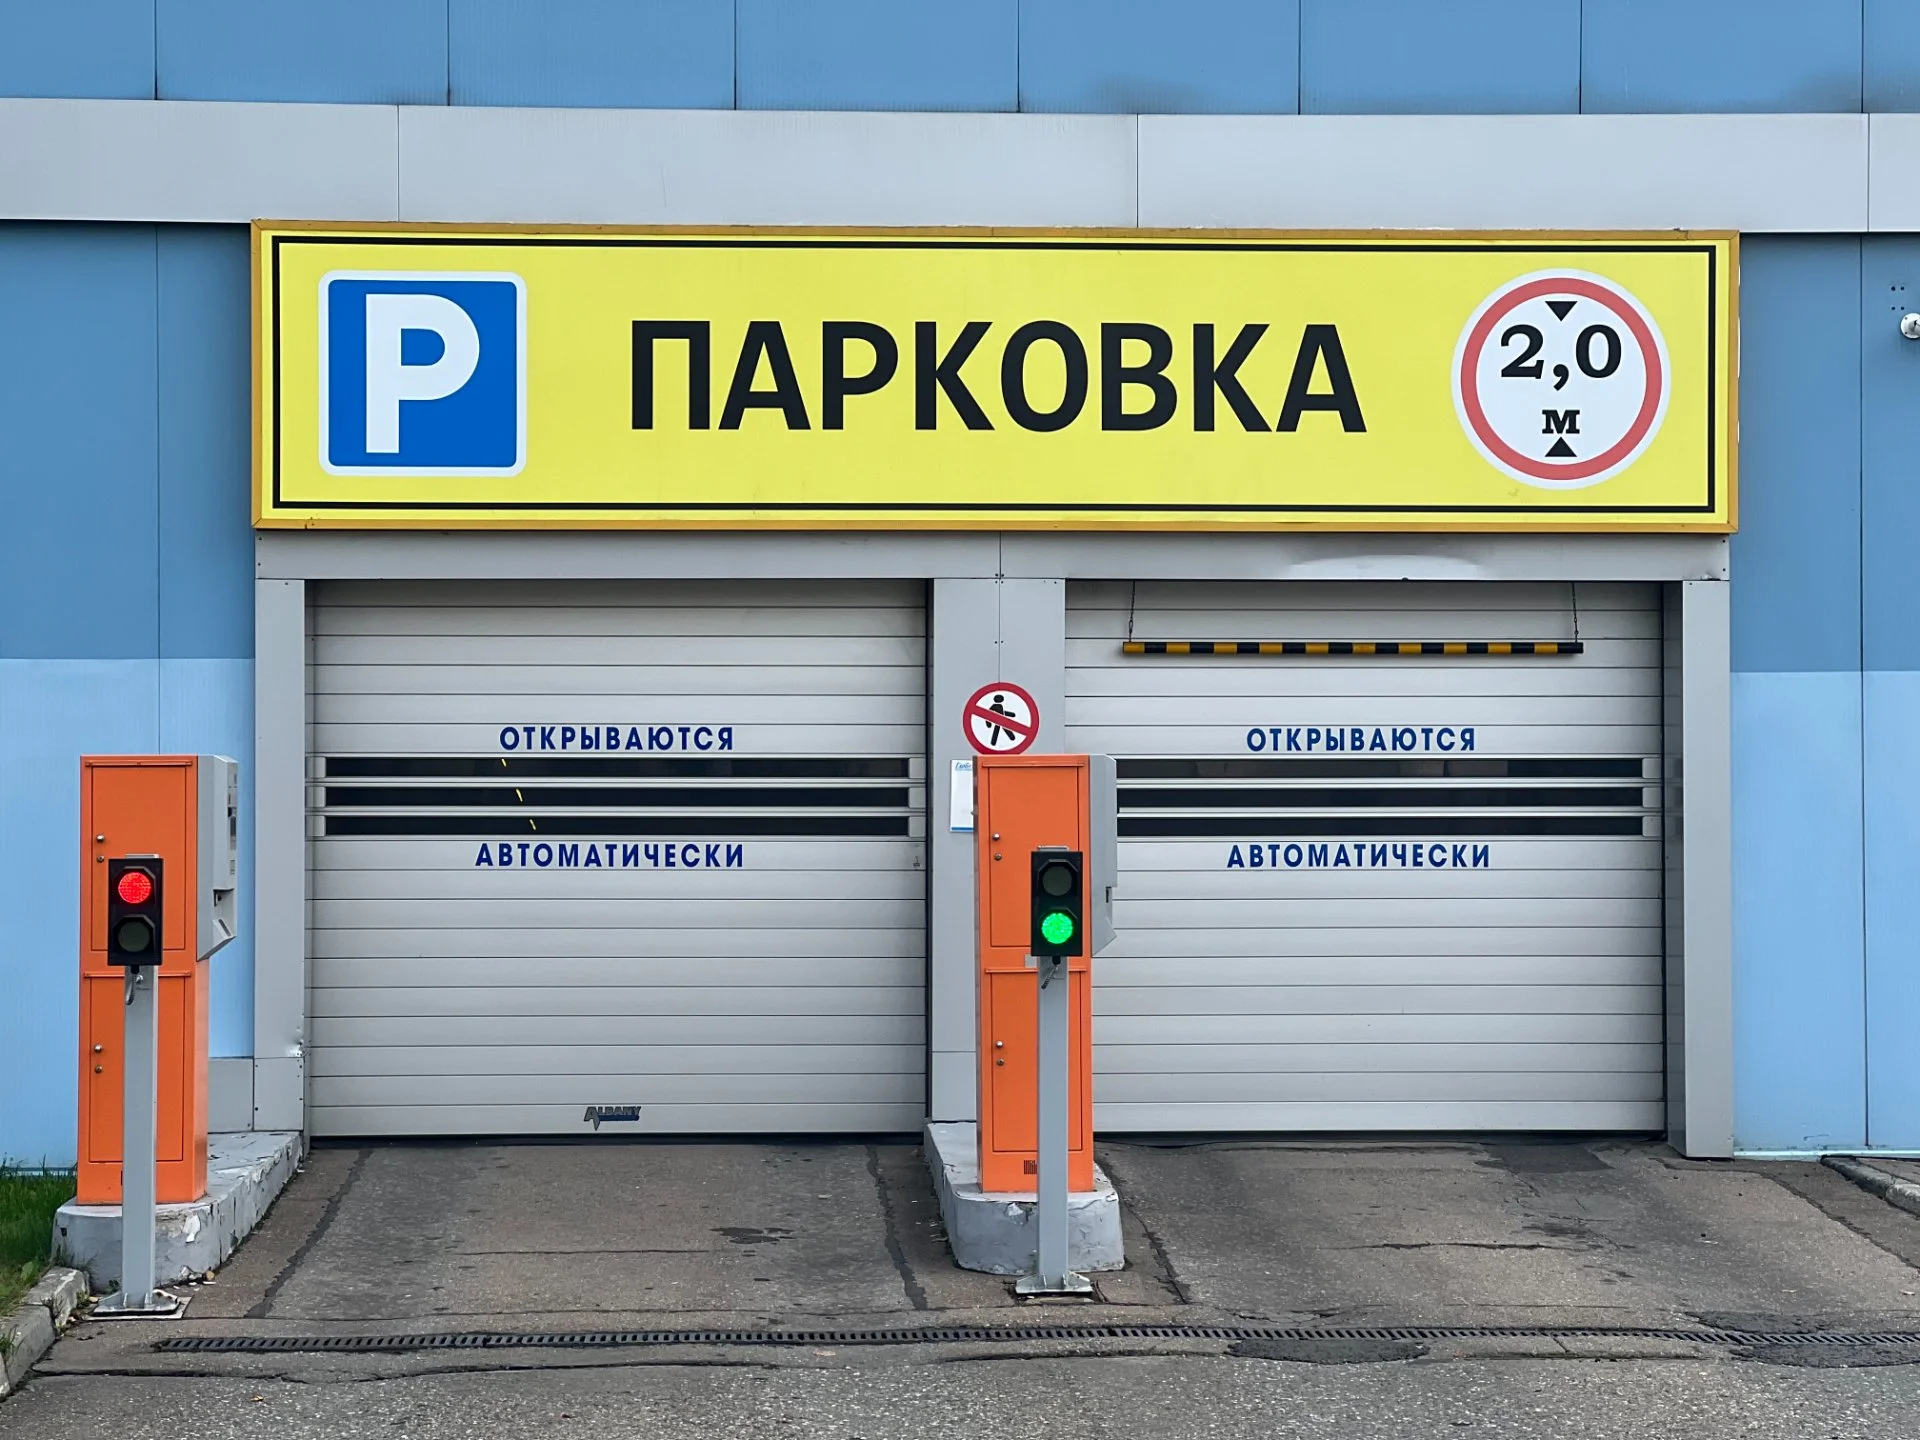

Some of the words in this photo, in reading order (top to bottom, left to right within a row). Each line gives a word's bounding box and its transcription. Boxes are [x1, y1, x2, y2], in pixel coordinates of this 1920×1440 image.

[1501, 324, 1621, 391] 2,0
[366, 294, 480, 454] P
[632, 321, 1367, 432] ПАРКОВКА
[500, 726, 733, 751] ОТКРЫВАЮТСЯ
[1247, 728, 1475, 752] ОТКРЫВАЮТСЯ
[475, 843, 743, 867] АВТОМАТИЧЕСКИ
[1227, 844, 1489, 868] АВТОМАТИЧЕСКИ
[584, 1106, 642, 1131] ALBANY
